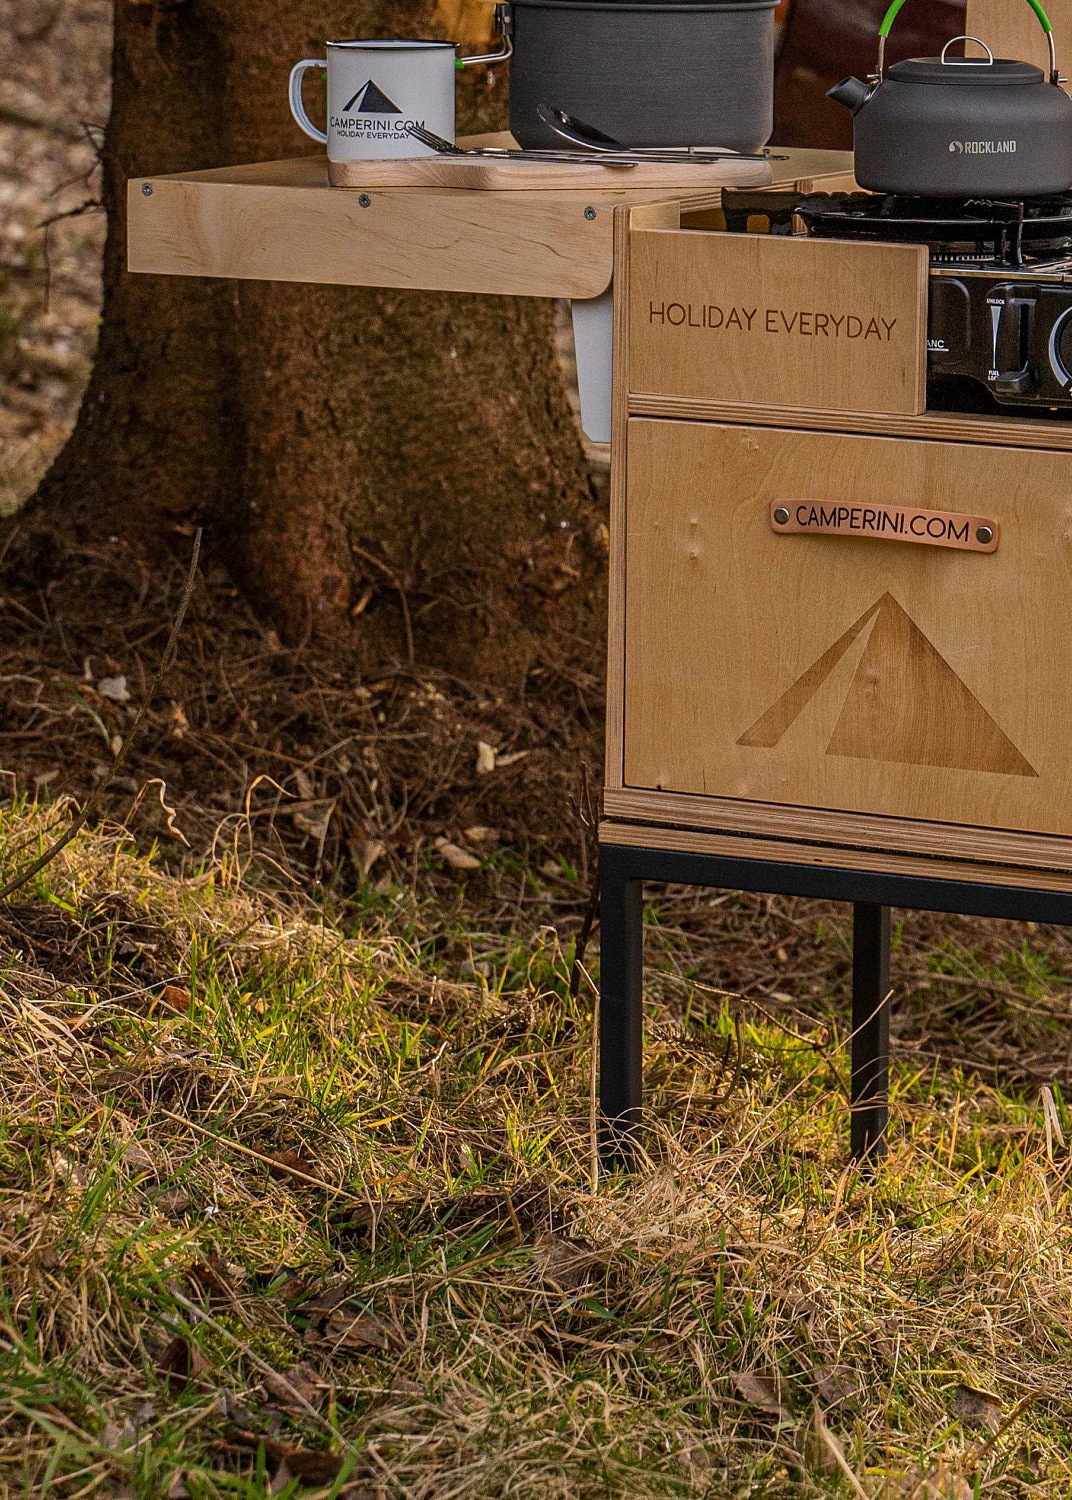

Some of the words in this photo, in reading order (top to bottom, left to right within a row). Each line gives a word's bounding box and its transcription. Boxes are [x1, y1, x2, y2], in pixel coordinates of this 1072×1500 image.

[330, 116, 425, 131] CAMPERINI.COM
[337, 130, 364, 139] HOLIDAY
[366, 132, 410, 140] EVERYDAY
[964, 140, 1017, 154] ROCKLAND
[649, 301, 757, 332] HOLIDAY
[765, 309, 897, 342] EVERYDAY
[927, 339, 945, 349] ANC
[796, 505, 970, 542] CAMPERINI.COM
